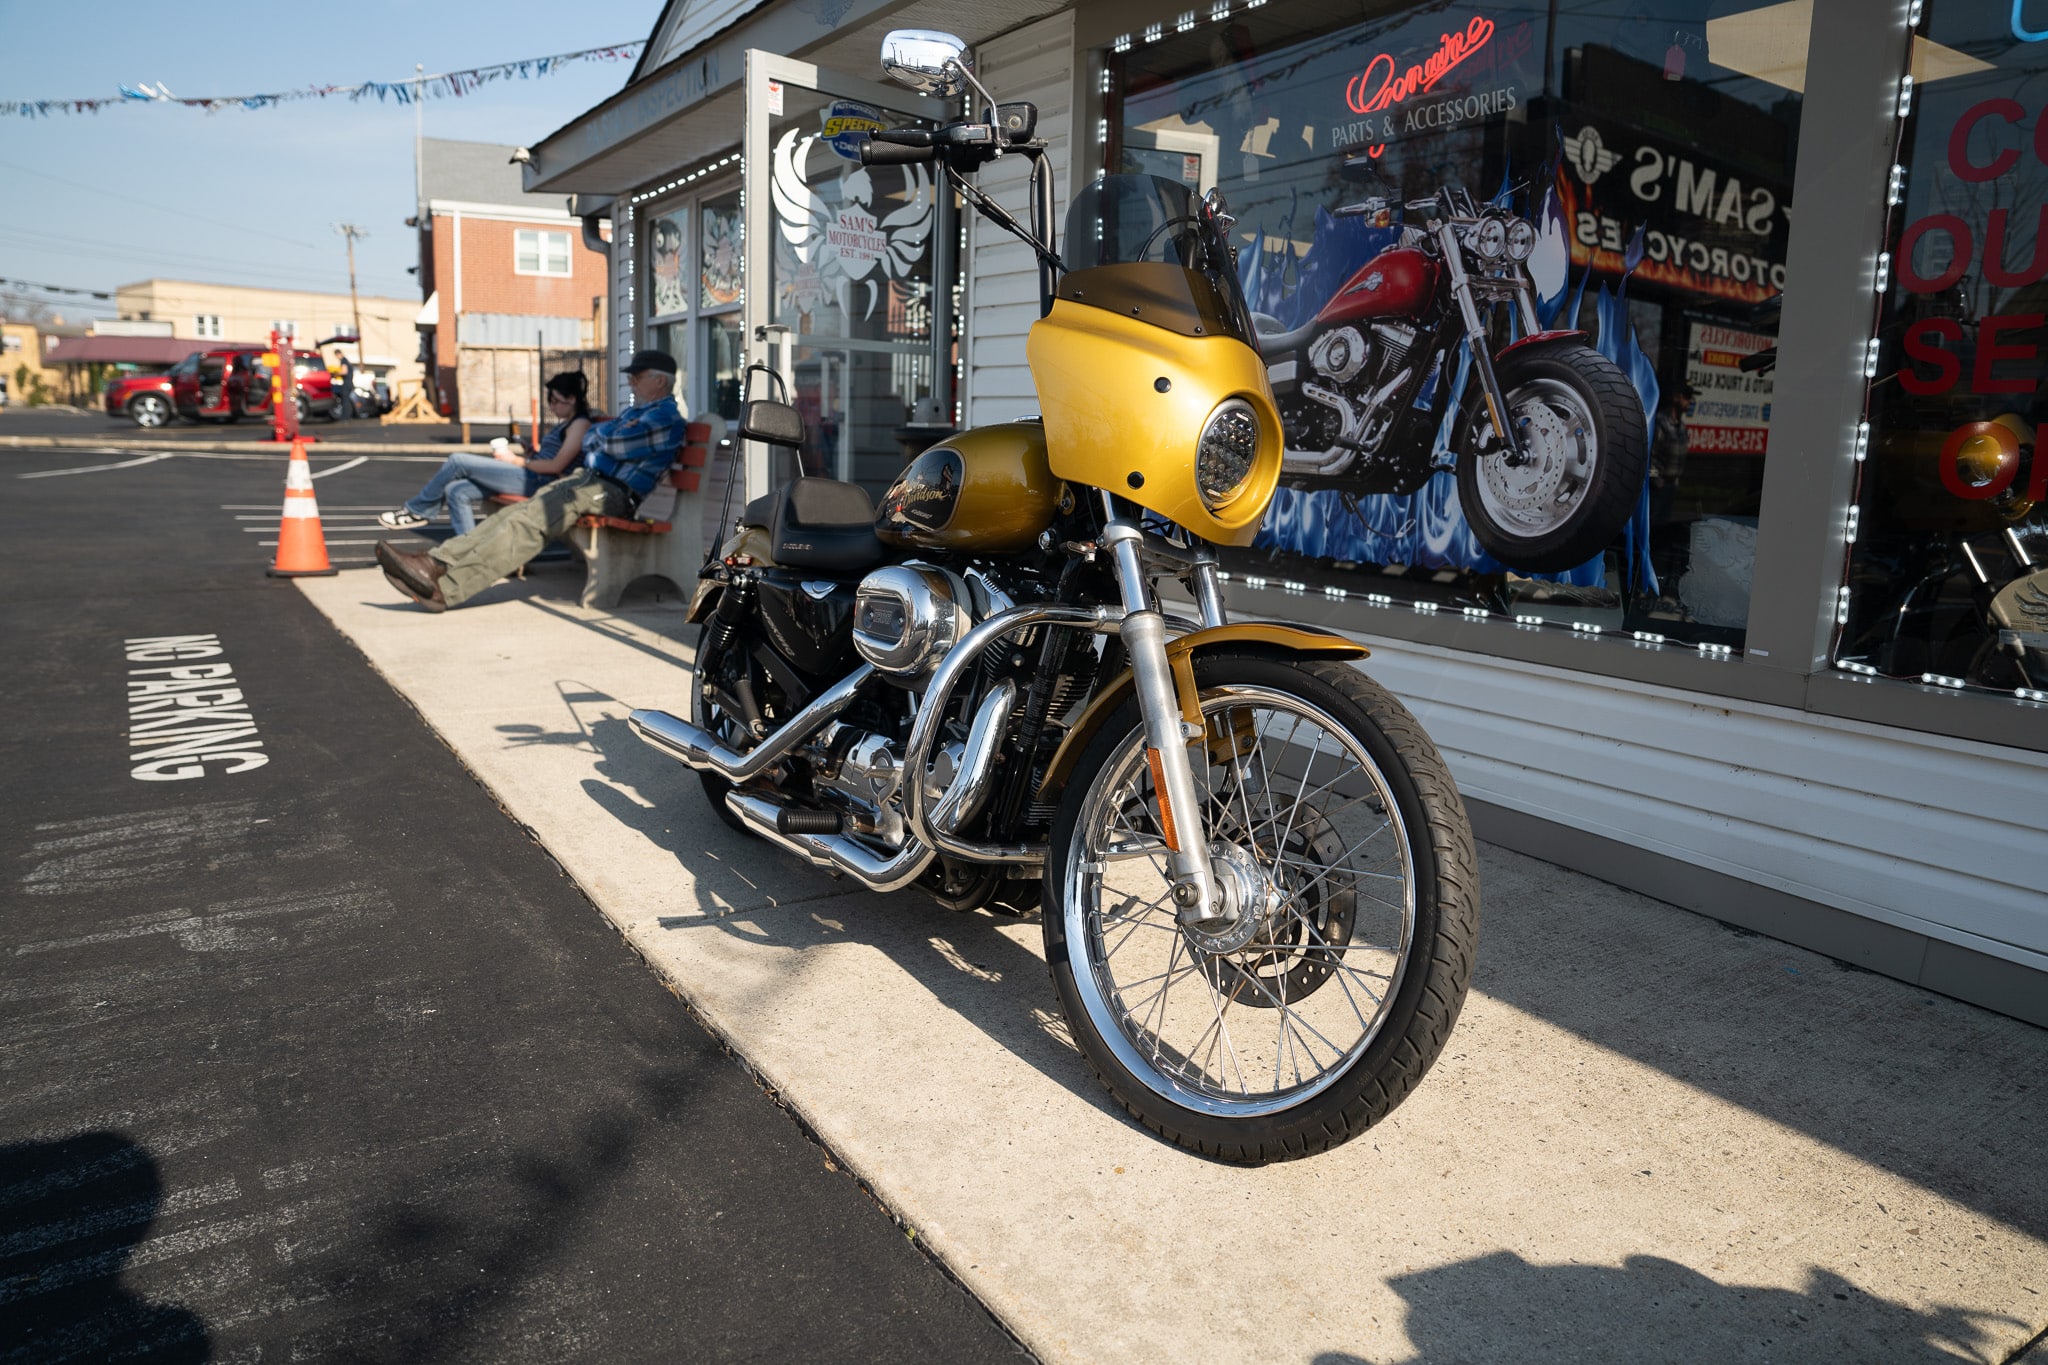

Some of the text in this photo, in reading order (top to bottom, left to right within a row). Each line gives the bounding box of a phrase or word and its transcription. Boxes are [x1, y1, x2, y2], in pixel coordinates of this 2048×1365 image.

[1332, 87, 1516, 147] PARTS & ACCESSORIES
[1947, 97, 2048, 184] C
[829, 230, 887, 252] MOTORCYCLES
[840, 214, 875, 234] SAM'S
[1939, 421, 2048, 502] O
[124, 633, 270, 781] NO PARKING
